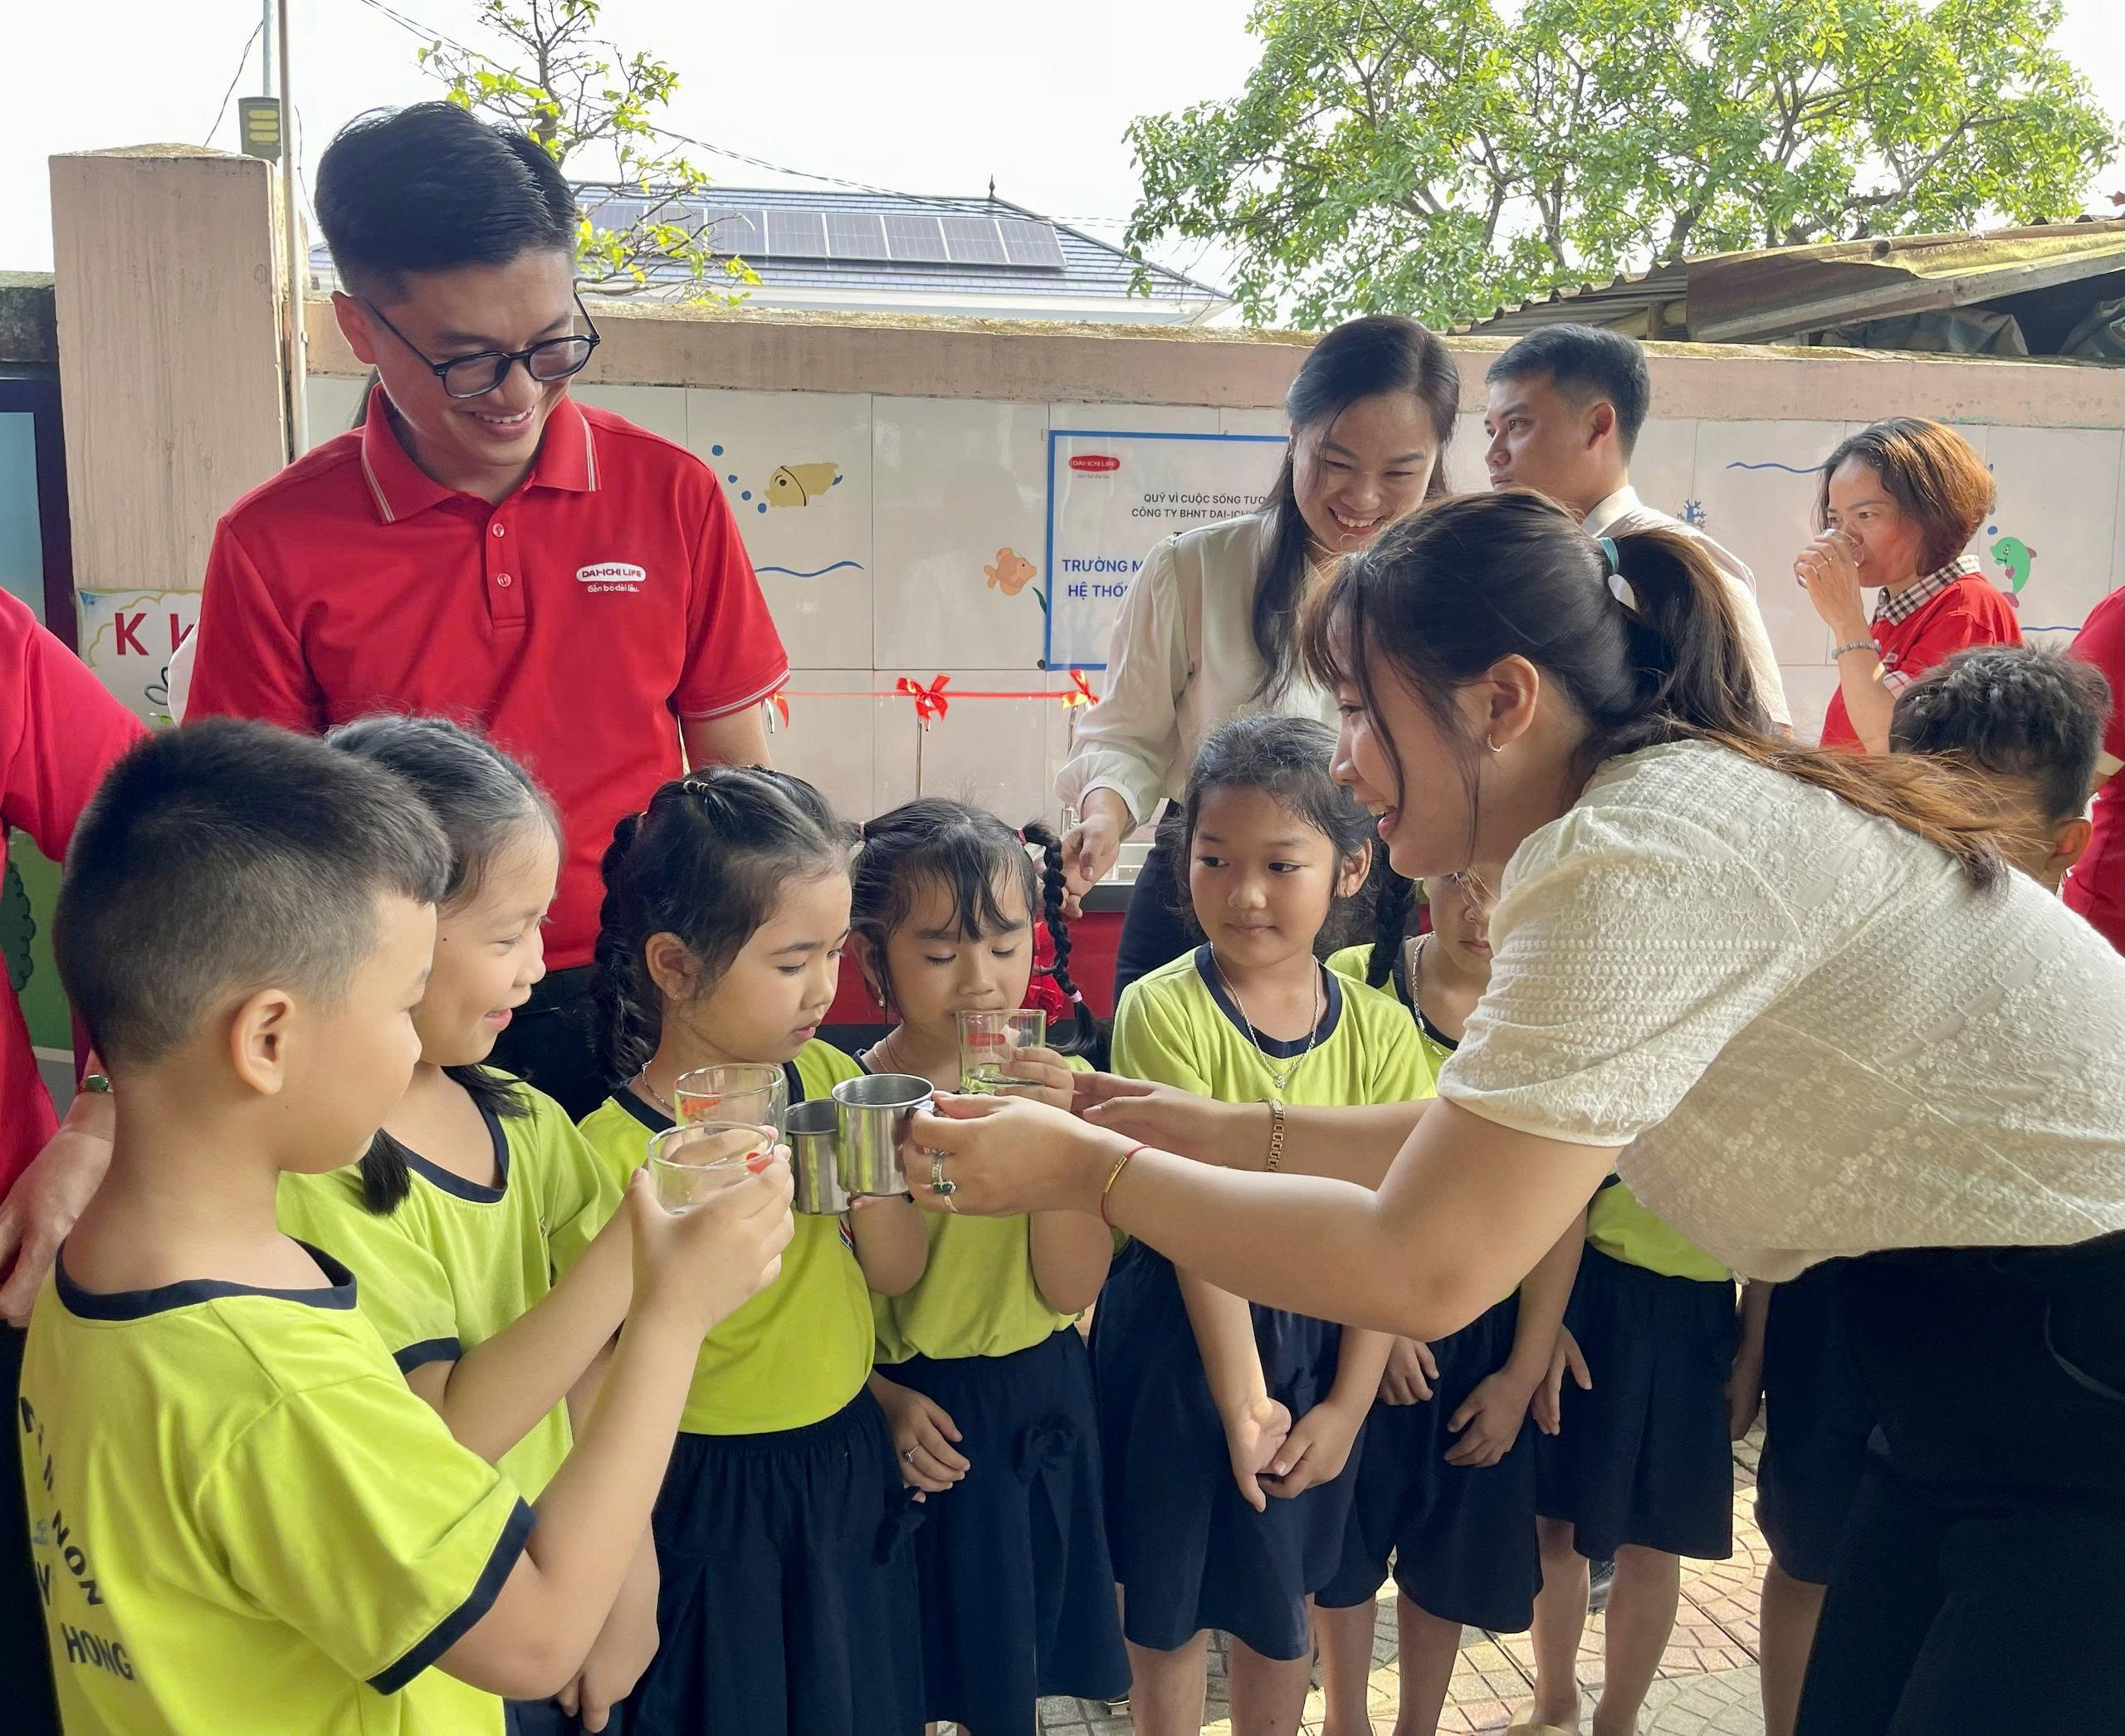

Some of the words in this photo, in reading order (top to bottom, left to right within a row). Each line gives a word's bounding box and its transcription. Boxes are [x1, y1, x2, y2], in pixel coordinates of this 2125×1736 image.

[1144, 491, 1165, 503] QUỸ
[1169, 491, 1179, 503] VÌ
[1180, 493, 1210, 506] CUỘC
[1213, 492, 1241, 505] SỐNG
[1131, 506, 1161, 518] CÔNG
[1164, 509, 1177, 518] TY
[1180, 509, 1207, 519] BHNT
[1062, 555, 1128, 573] TRƯỜNG
[623, 569, 642, 578] LIFE
[1068, 581, 1088, 600] HỆ
[115, 613, 150, 656] K
